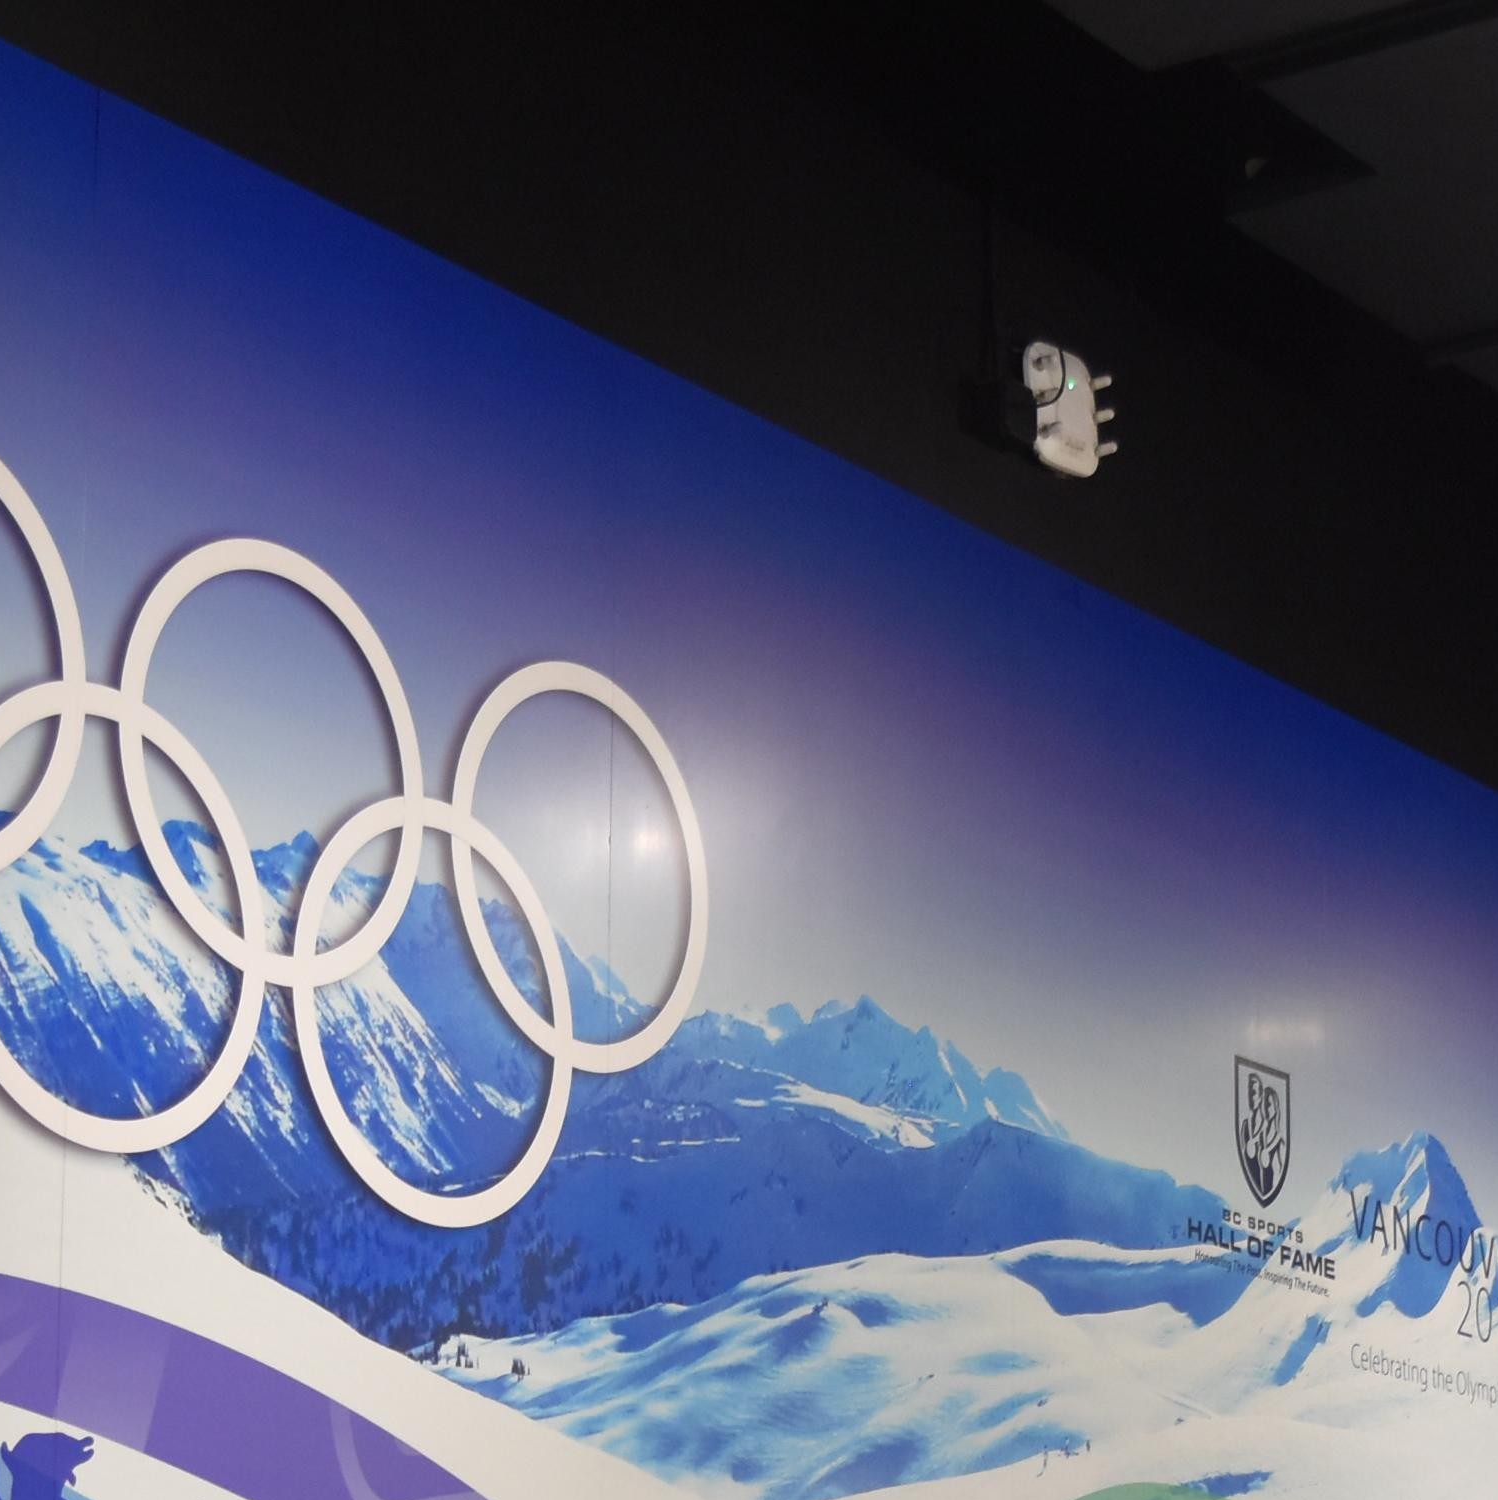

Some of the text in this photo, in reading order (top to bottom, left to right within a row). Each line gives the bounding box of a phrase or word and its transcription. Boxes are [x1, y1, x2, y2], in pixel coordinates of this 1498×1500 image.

[1222, 1208, 1304, 1244] BC SPORTS
[1187, 1217, 1336, 1280] HALL OF FAME
[1233, 1260, 1246, 1273] The
[1264, 1270, 1293, 1290] Inspiring
[1294, 1277, 1306, 1289] The
[1350, 1343, 1428, 1392] Celebrating
[1432, 1364, 1453, 1392] the
